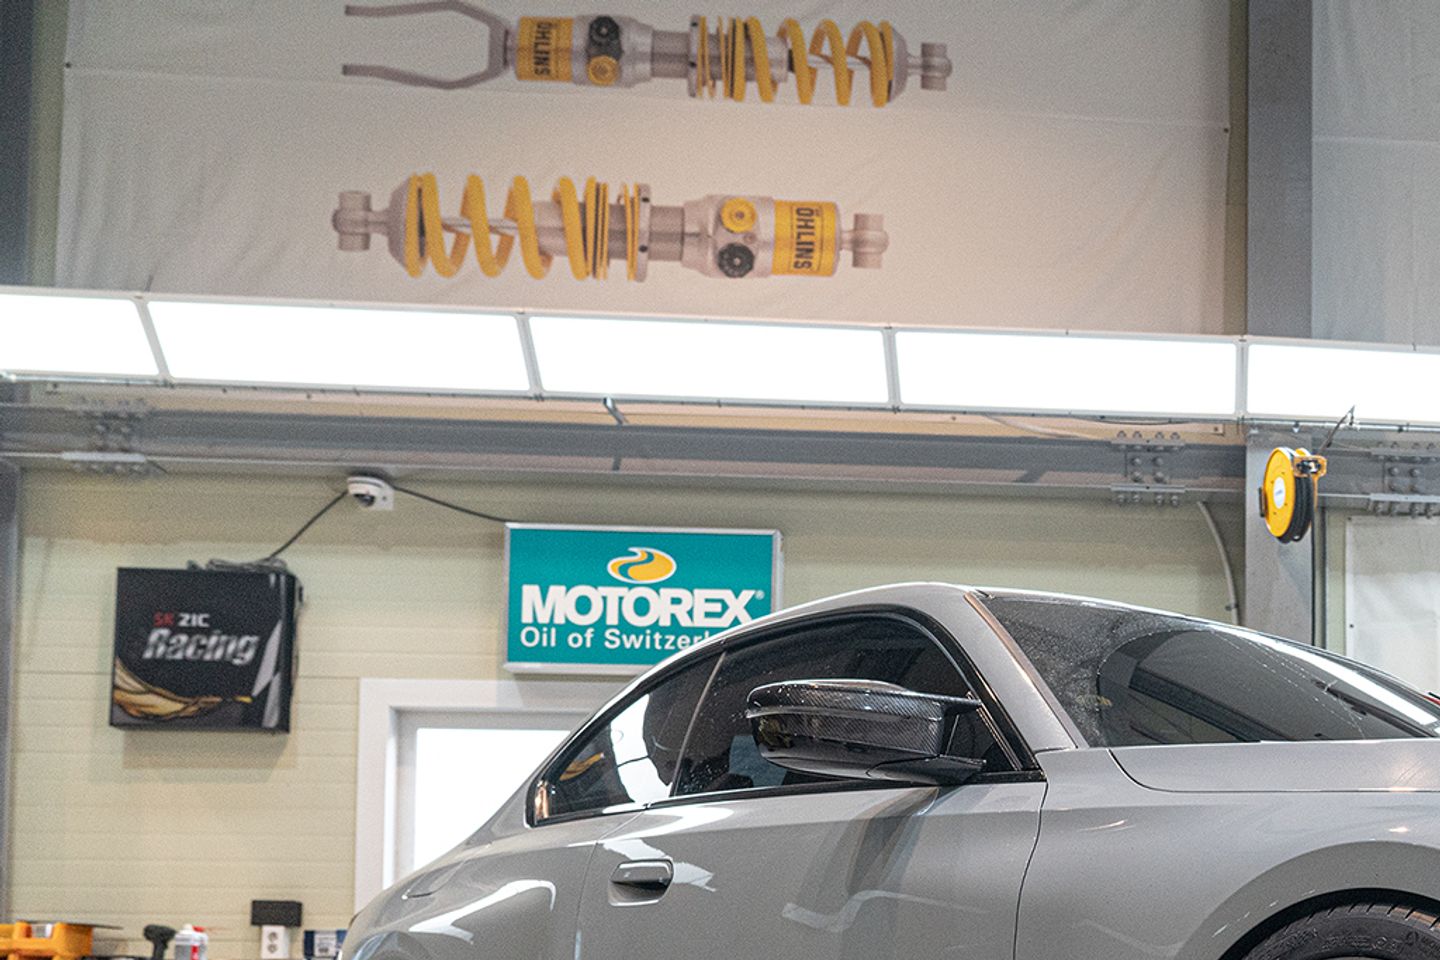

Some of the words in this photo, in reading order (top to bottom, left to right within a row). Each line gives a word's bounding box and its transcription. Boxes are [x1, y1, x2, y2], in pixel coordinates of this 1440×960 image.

[178, 612, 210, 628] ZIC
[521, 584, 756, 628] MOTOREX
[142, 627, 260, 666] Racing
[520, 626, 556, 648] Oil
[568, 628, 594, 649] of
